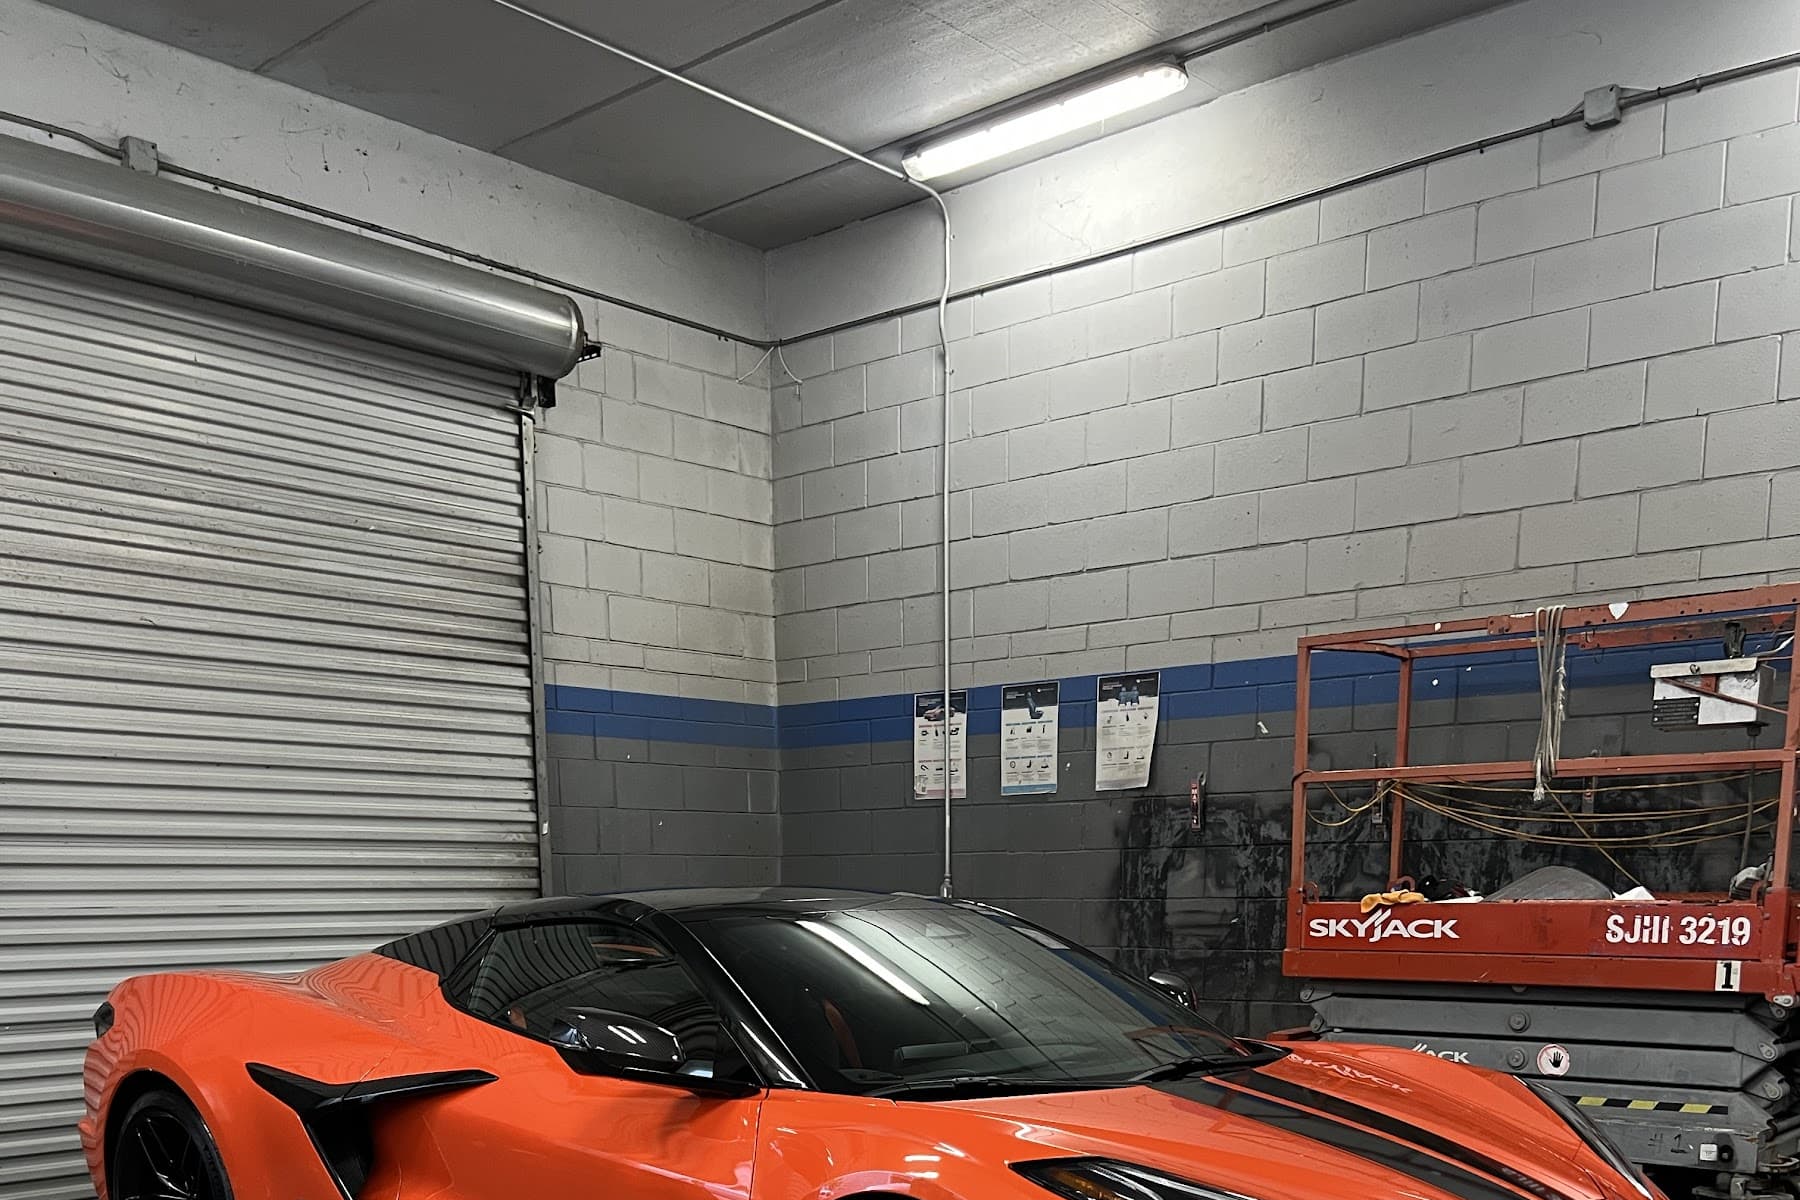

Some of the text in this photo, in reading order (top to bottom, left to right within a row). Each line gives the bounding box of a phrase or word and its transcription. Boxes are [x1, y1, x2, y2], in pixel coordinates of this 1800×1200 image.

[1309, 908, 1460, 943] SKYJACK
[1679, 913, 1751, 945] 3219
[1721, 962, 1734, 990] 1
